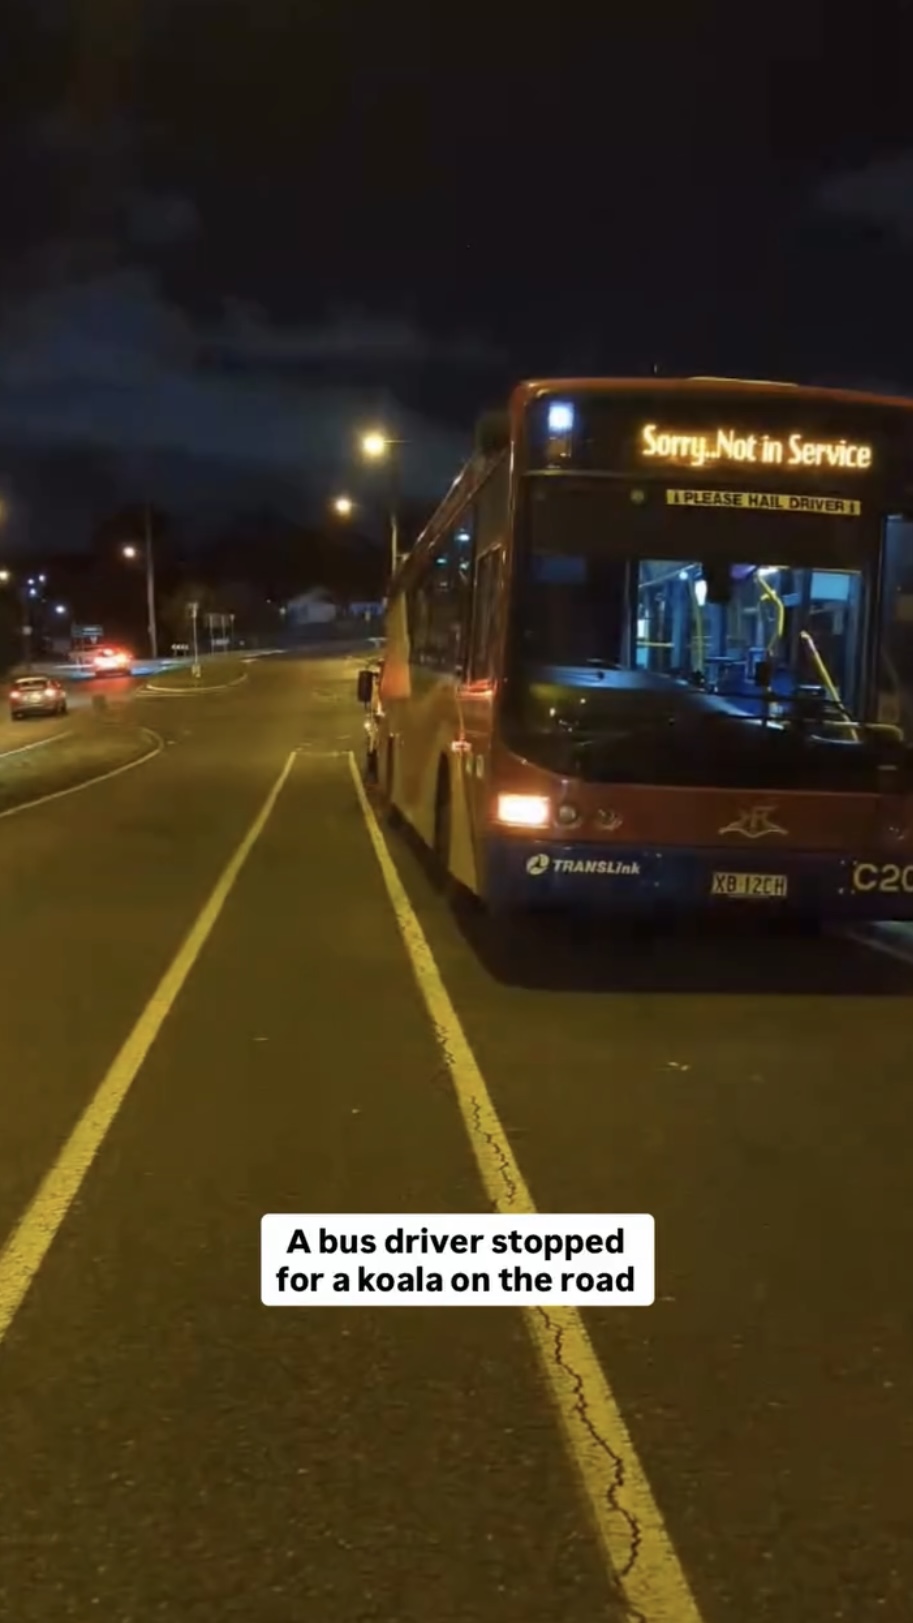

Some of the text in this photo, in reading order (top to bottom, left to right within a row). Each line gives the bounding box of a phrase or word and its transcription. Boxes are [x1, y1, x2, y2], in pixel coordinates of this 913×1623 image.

[761, 435, 783, 463] in
[787, 433, 873, 468] Service
[684, 492, 844, 512] PLEASE HAIL DRIVER
